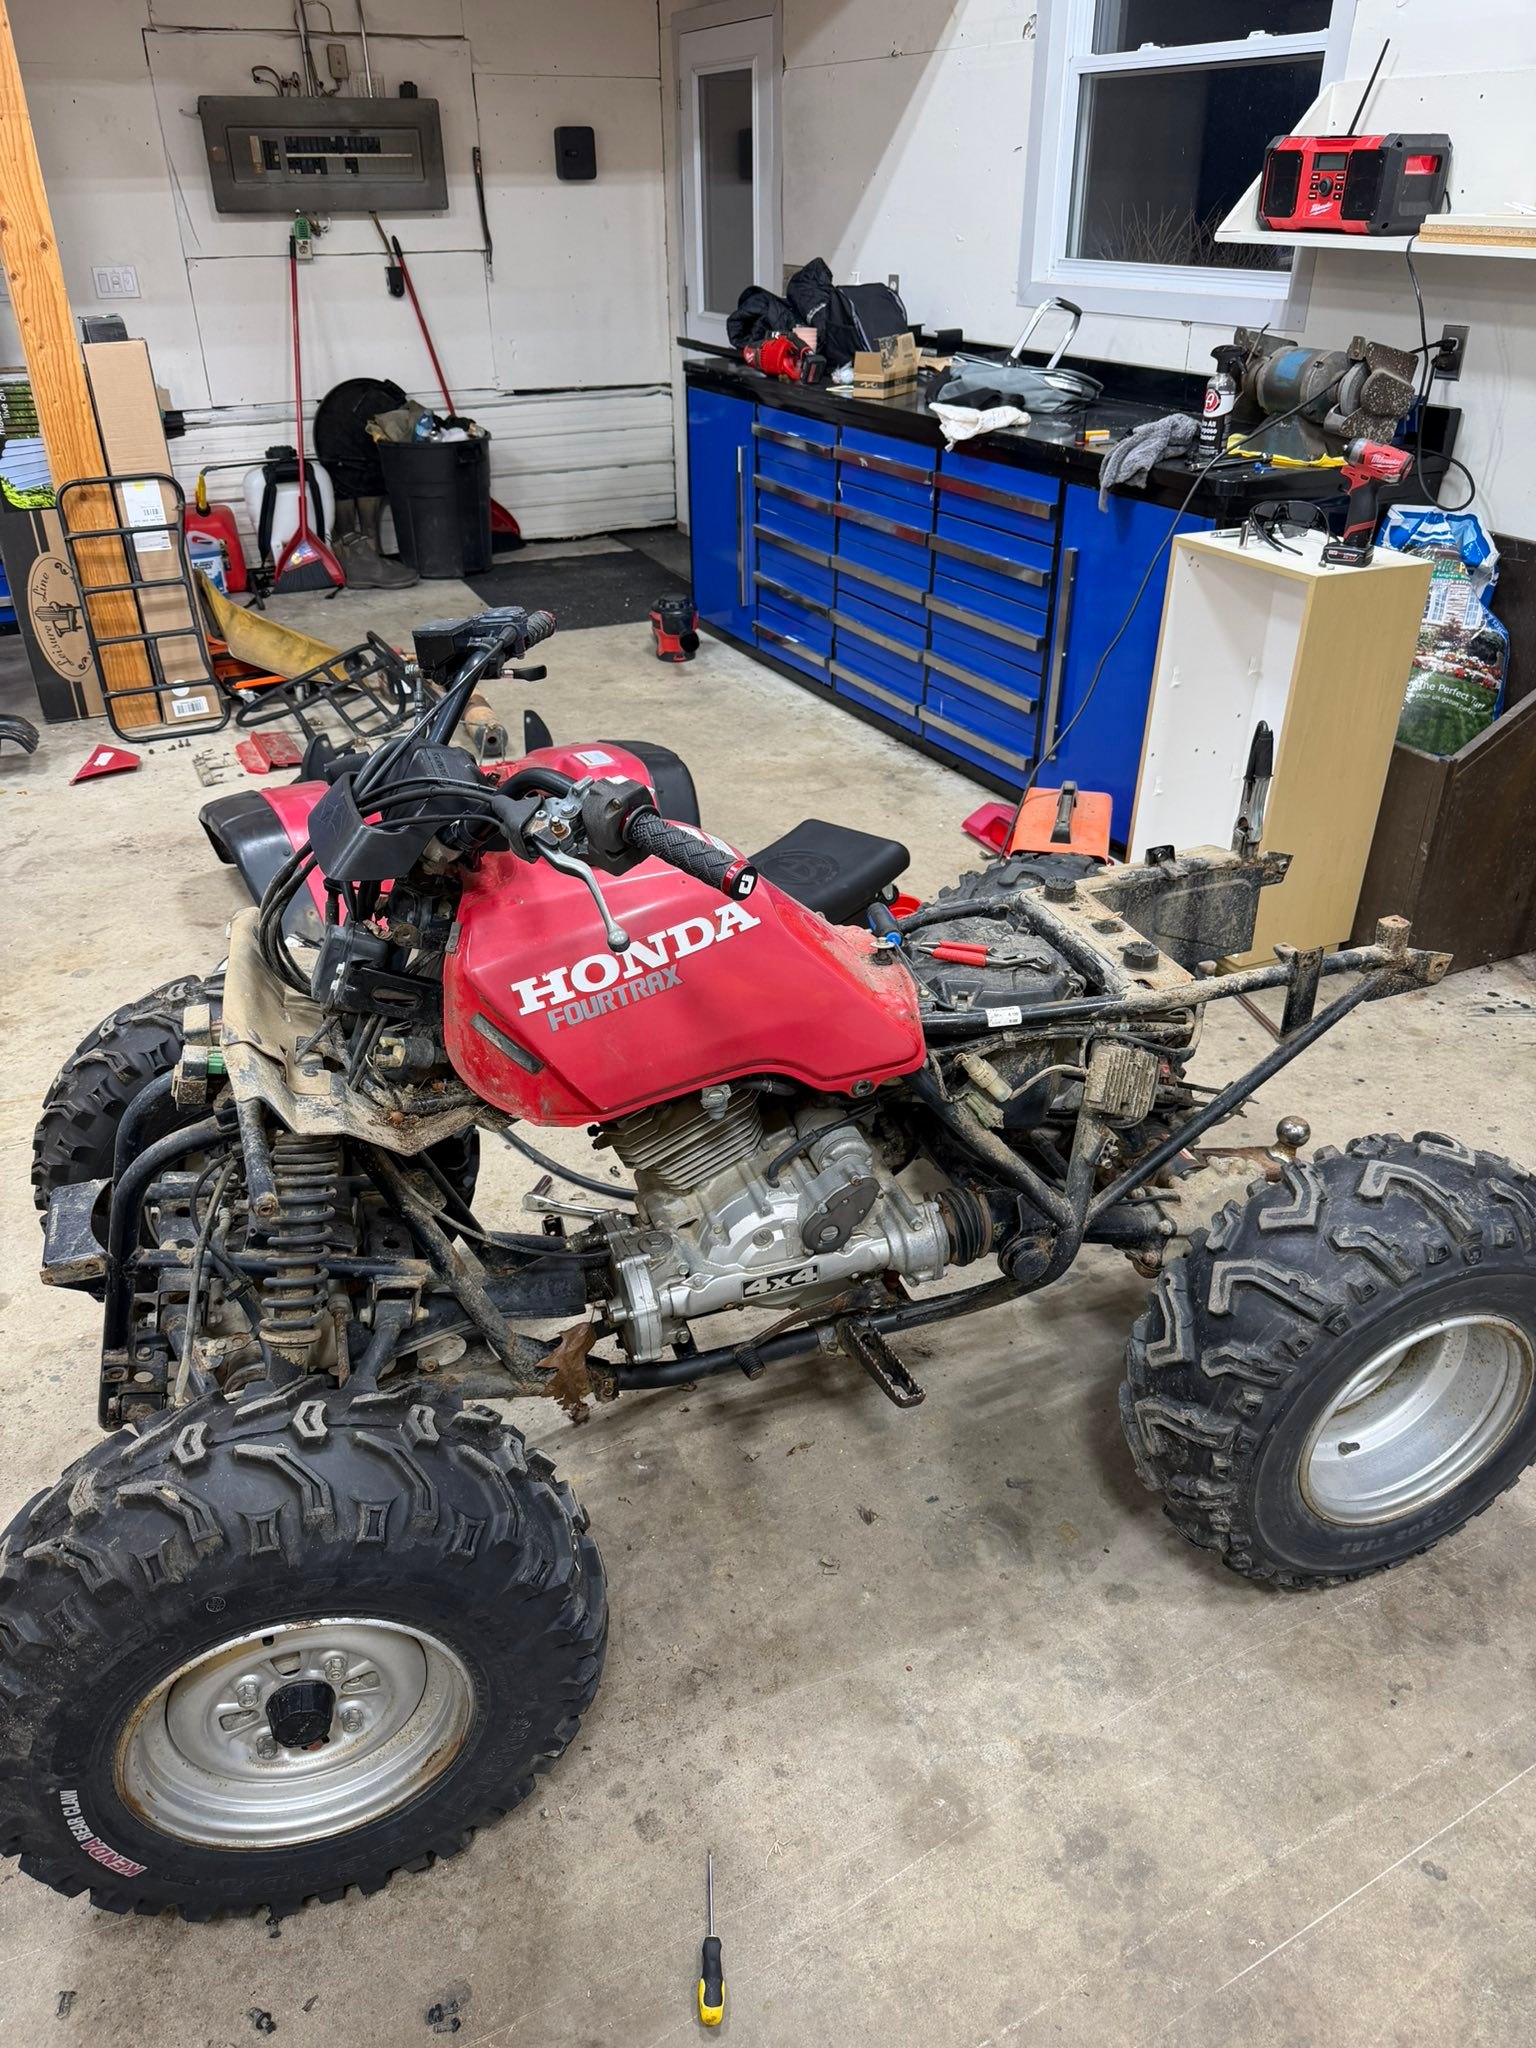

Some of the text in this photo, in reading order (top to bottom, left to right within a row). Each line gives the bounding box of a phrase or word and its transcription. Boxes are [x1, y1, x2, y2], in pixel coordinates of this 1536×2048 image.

[32, 572, 75, 667] Leisure Line
[1438, 683, 1470, 701] Perfect
[1471, 695, 1486, 709] Turf
[510, 901, 762, 1016] HONDA
[547, 963, 685, 1033] FOURTRAX
[744, 1266, 818, 1296] 4x4
[60, 1789, 148, 1878] KENDA BEAR CLAW
